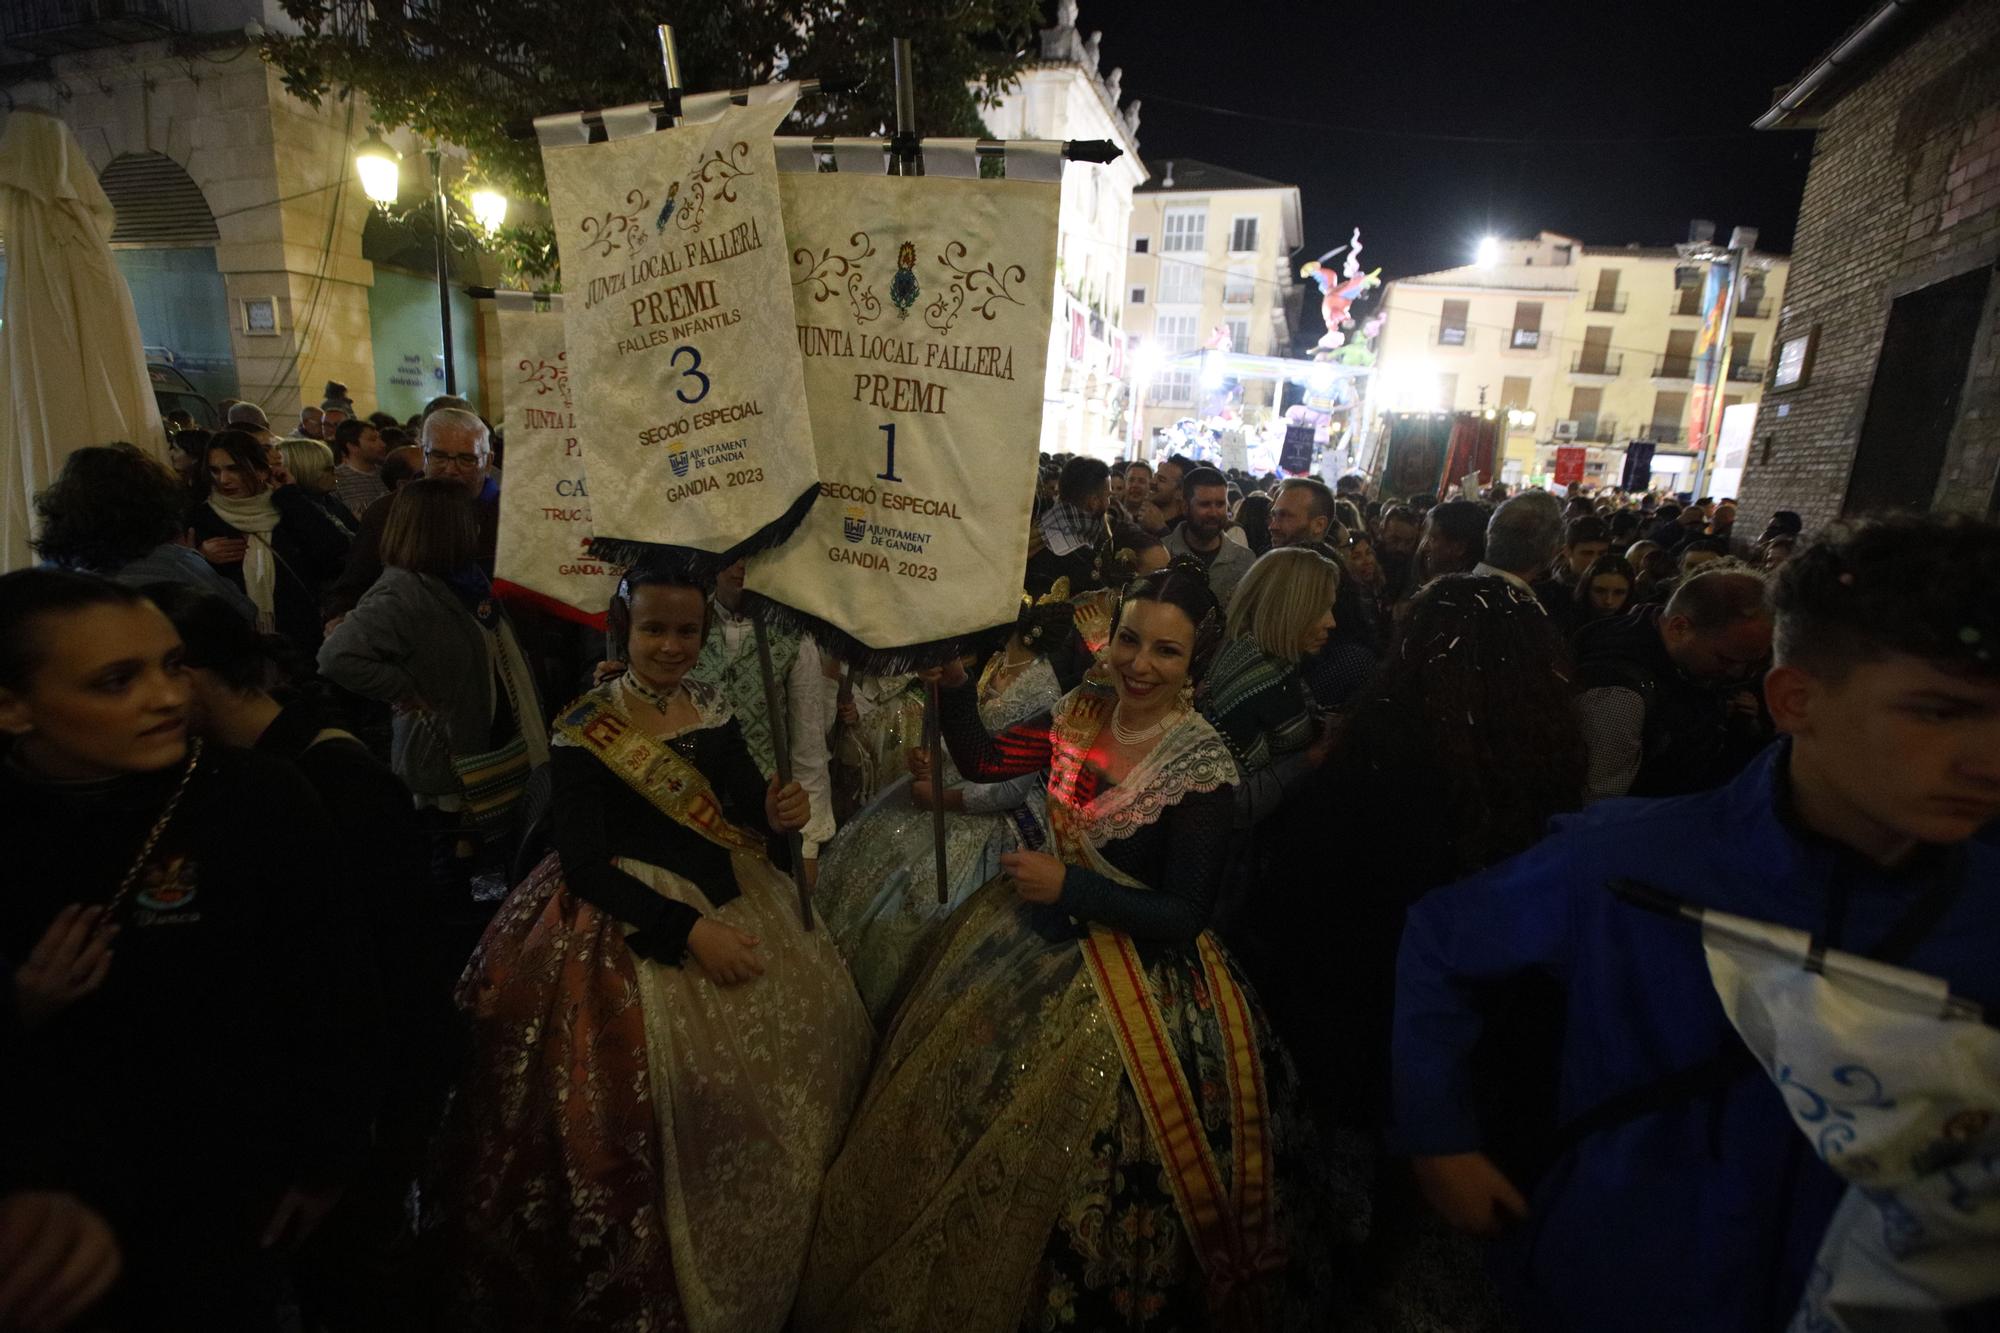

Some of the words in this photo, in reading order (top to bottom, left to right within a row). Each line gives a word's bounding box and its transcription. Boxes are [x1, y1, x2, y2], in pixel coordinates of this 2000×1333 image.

[631, 251, 682, 286] LOCAL
[684, 216, 762, 268] FALLERA
[630, 279, 720, 328] PREMI
[617, 330, 669, 355] FALLES
[672, 309, 742, 341] INFANTILS
[671, 346, 711, 404] 3
[860, 334, 919, 365] LOCAL
[924, 342, 1015, 381] FALLERA
[853, 374, 948, 414] PREMI
[524, 409, 564, 429] JUNTA
[638, 416, 690, 446] SECCIÓ
[693, 400, 763, 430] ESPECIAL
[690, 438, 749, 461] AJUNTAMENT
[695, 460, 705, 469] DE
[708, 451, 745, 467] GANDIA
[876, 423, 903, 482] 1
[666, 475, 720, 503] GANDIA
[726, 467, 764, 488] 2023
[820, 482, 877, 505] SECCIÓ
[882, 493, 962, 520] ESPECIAL
[541, 508, 581, 521] TRUC
[867, 524, 932, 544] AJUNTAMENT
[871, 535, 883, 546] DE
[886, 537, 923, 554] GANDIA
[559, 564, 604, 577] GANDIA
[828, 547, 890, 573] GANDIA
[897, 561, 938, 582] 2023
